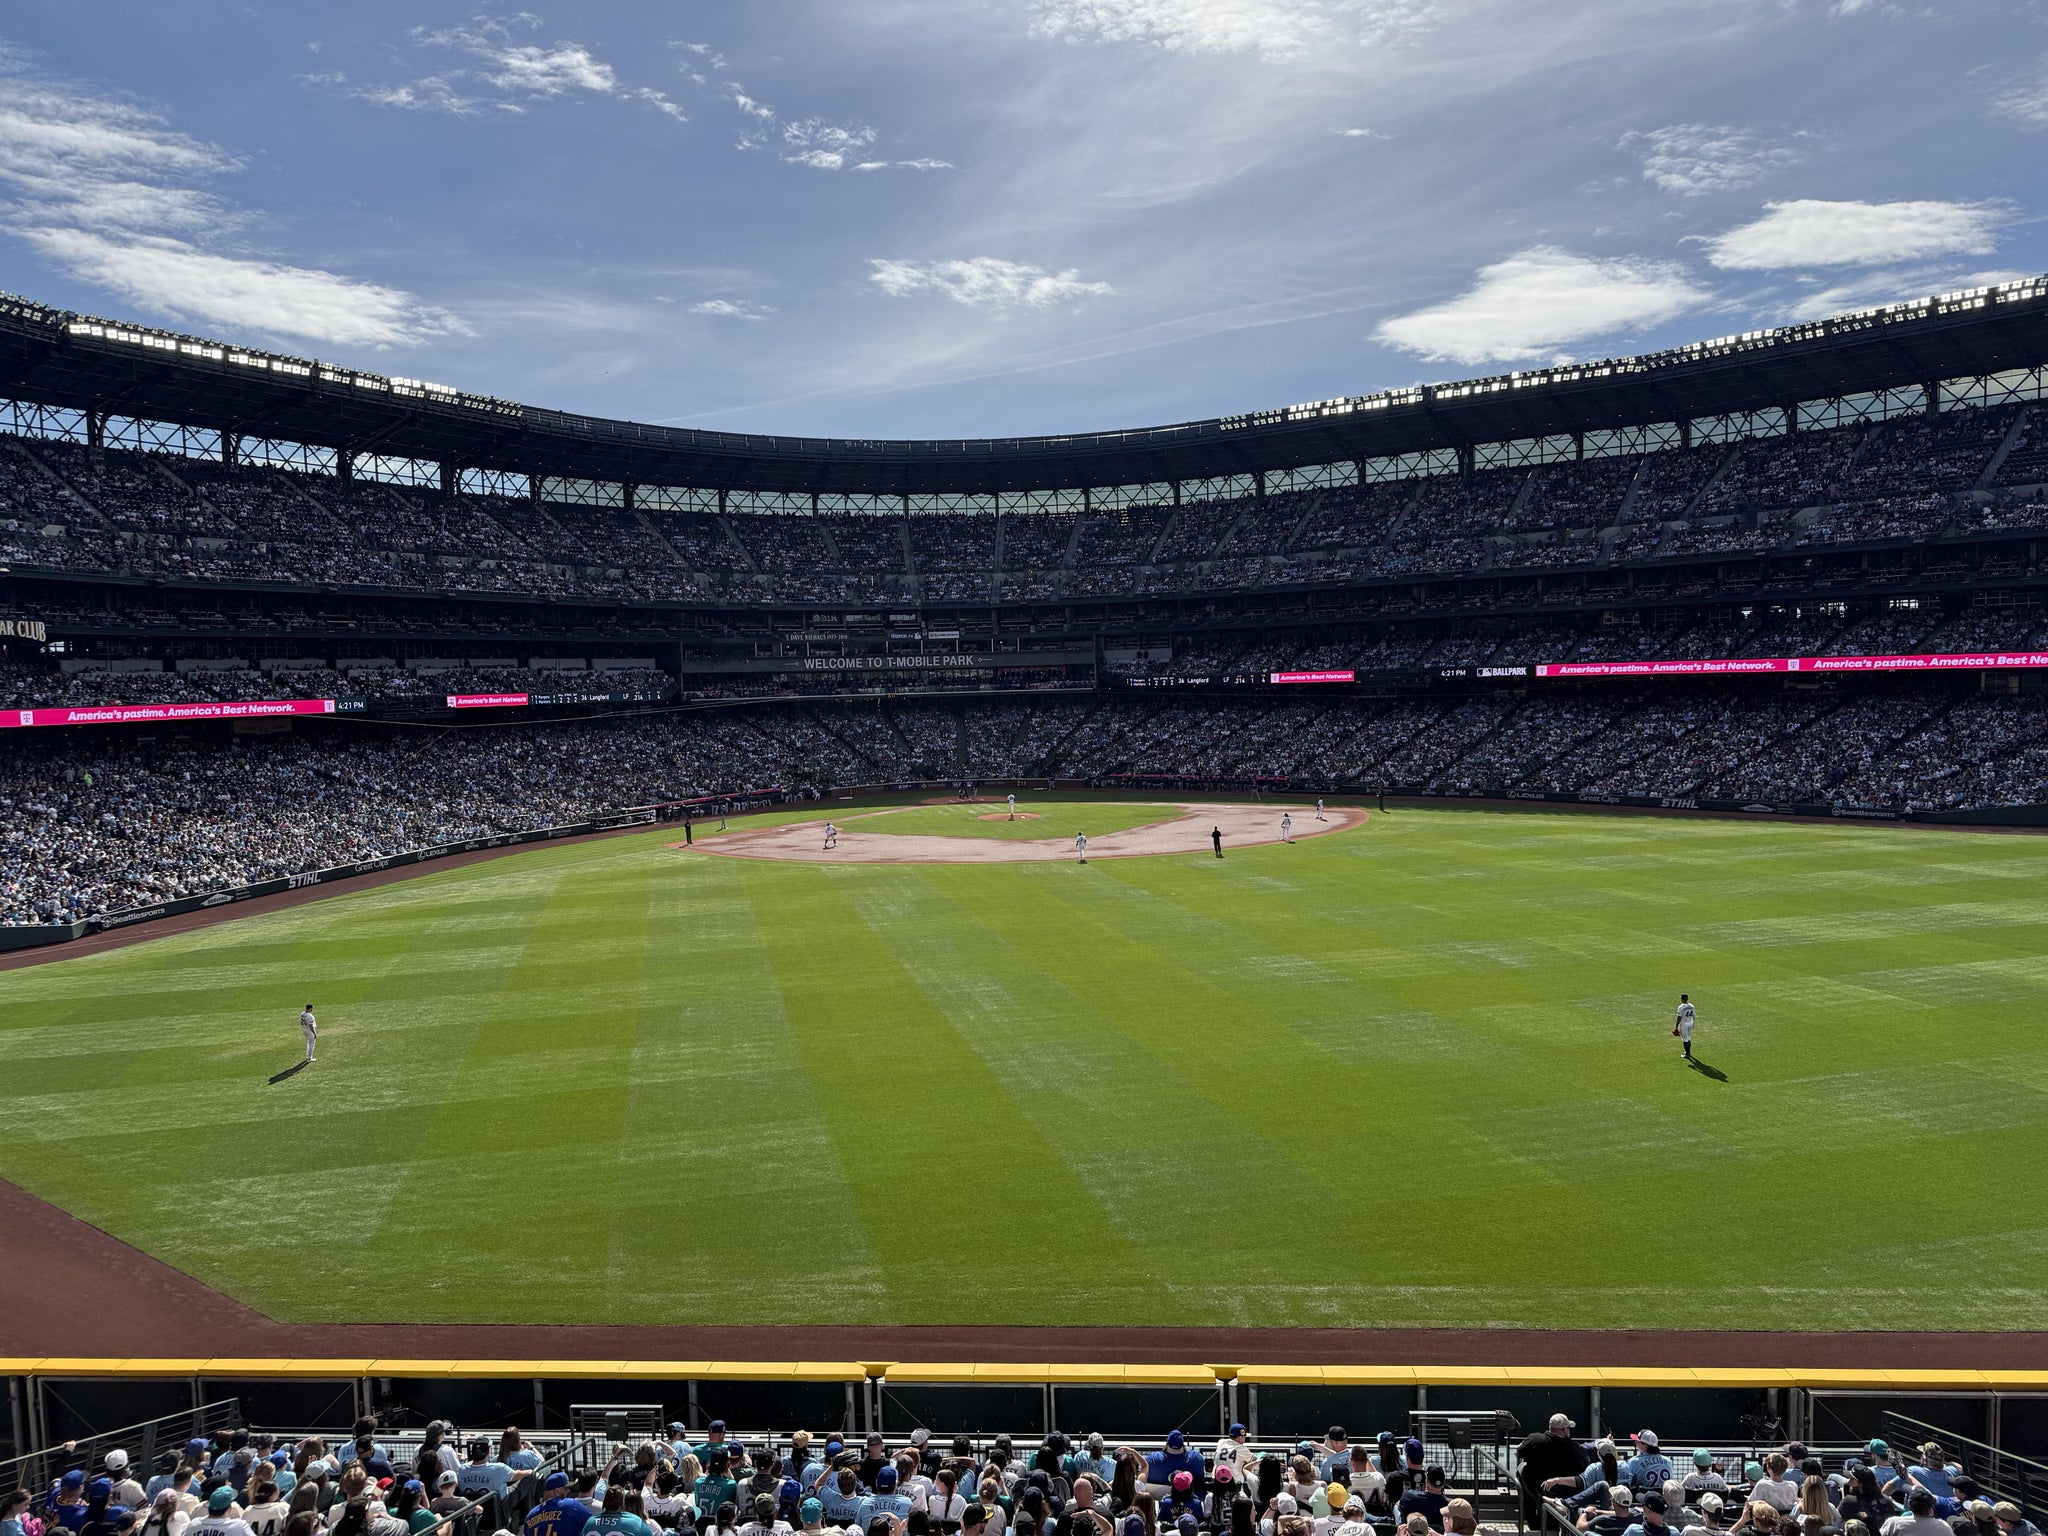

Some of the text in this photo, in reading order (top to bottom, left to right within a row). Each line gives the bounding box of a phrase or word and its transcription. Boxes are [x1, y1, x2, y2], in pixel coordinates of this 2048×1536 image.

[17, 620, 46, 642] CLUB
[804, 655, 974, 669] WELCOME TO T-MOBILE PARK
[1559, 661, 1776, 675] America's pastime. America's Best Network.
[1813, 659, 1872, 668] America's
[1873, 658, 1927, 669] pastime.
[1928, 657, 1995, 666] America's
[1996, 655, 2027, 665] Best
[1492, 667, 1527, 676] BALLPARK
[68, 703, 296, 721] America's pastime. America's Best Network.
[338, 701, 364, 710] 4:21 PM
[1578, 794, 1620, 804] Great Clips
[1660, 799, 1699, 809] STIHL
[425, 848, 448, 857] LEXUS
[354, 859, 390, 872] Great Clips
[288, 872, 322, 889] STIHL
[1219, 1447, 1238, 1463] 24
[1640, 1457, 1668, 1469] RALEIGH
[463, 1473, 491, 1483] RALEIGH
[1646, 1469, 1671, 1488] 29
[699, 1482, 722, 1496] ICHIRO
[699, 1497, 715, 1516] 51
[869, 1500, 901, 1515] RALEIGH
[526, 1509, 563, 1529] RODRÍGUEZ
